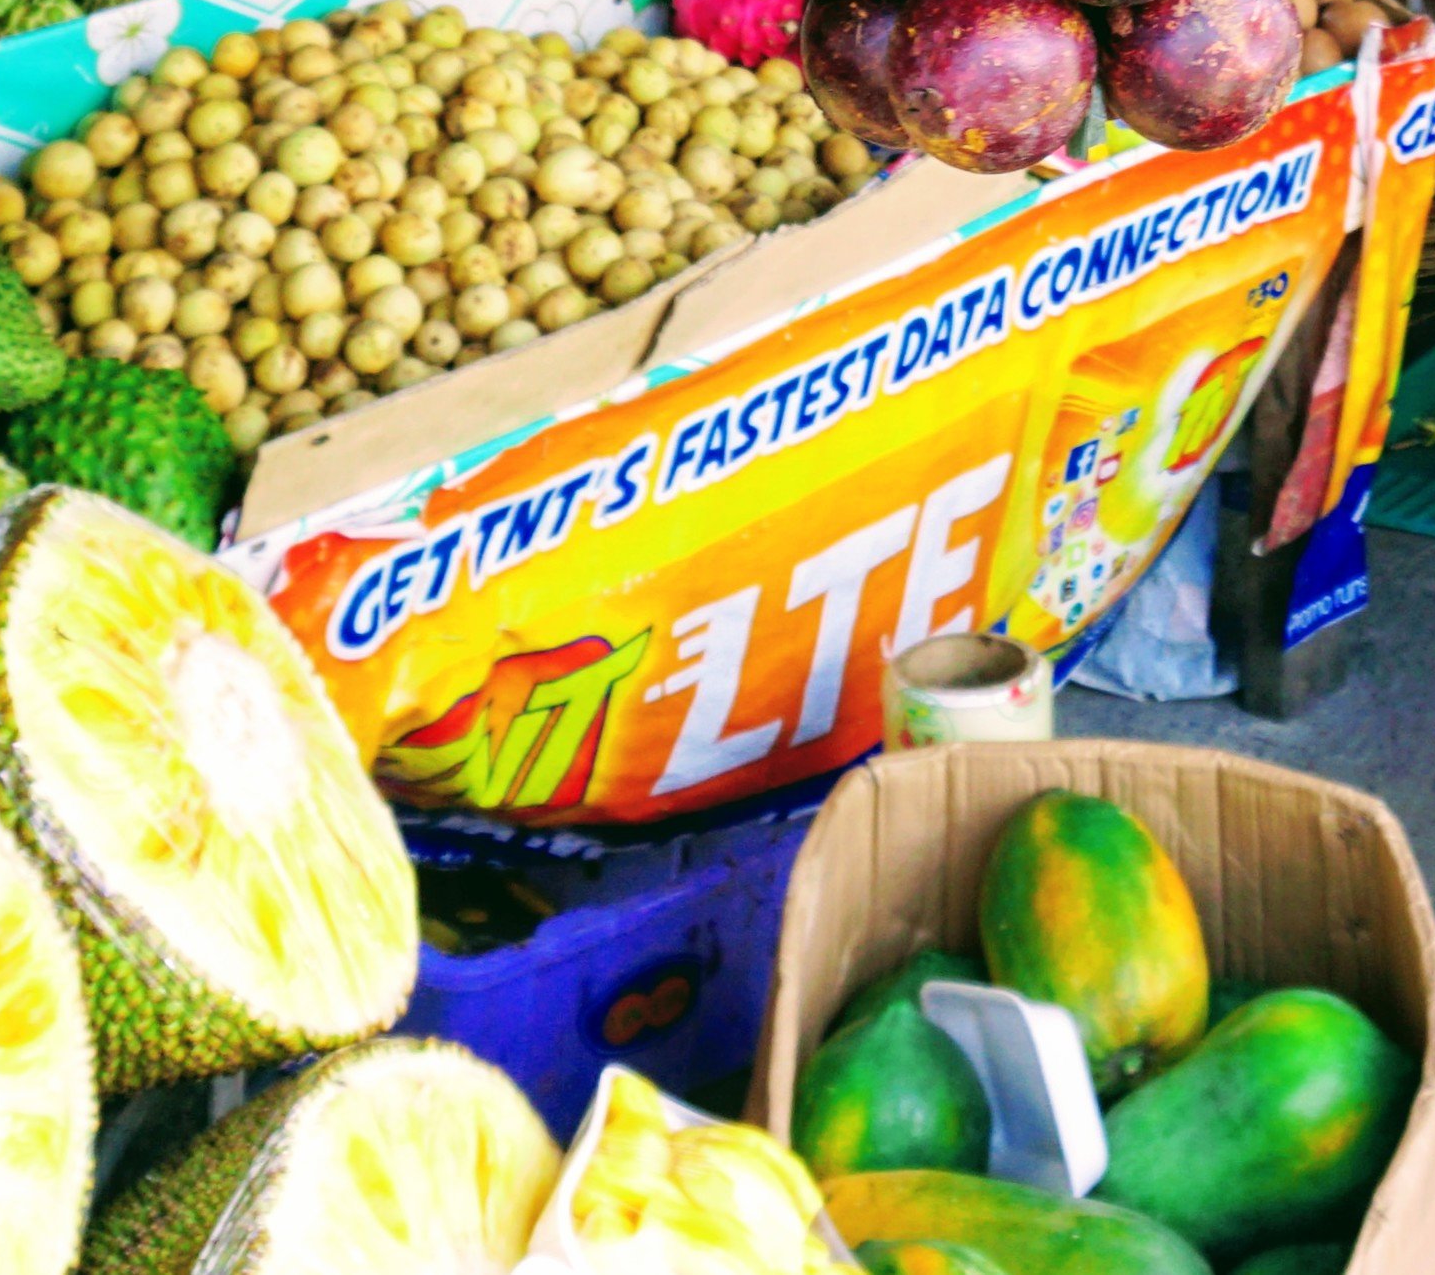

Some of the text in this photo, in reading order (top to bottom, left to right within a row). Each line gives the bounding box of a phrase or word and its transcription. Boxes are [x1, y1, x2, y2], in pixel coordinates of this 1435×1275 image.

[338, 149, 1316, 649] GET TNT'S FASTEST DATA CONNECTION!
[650, 453, 1013, 798] LTE
